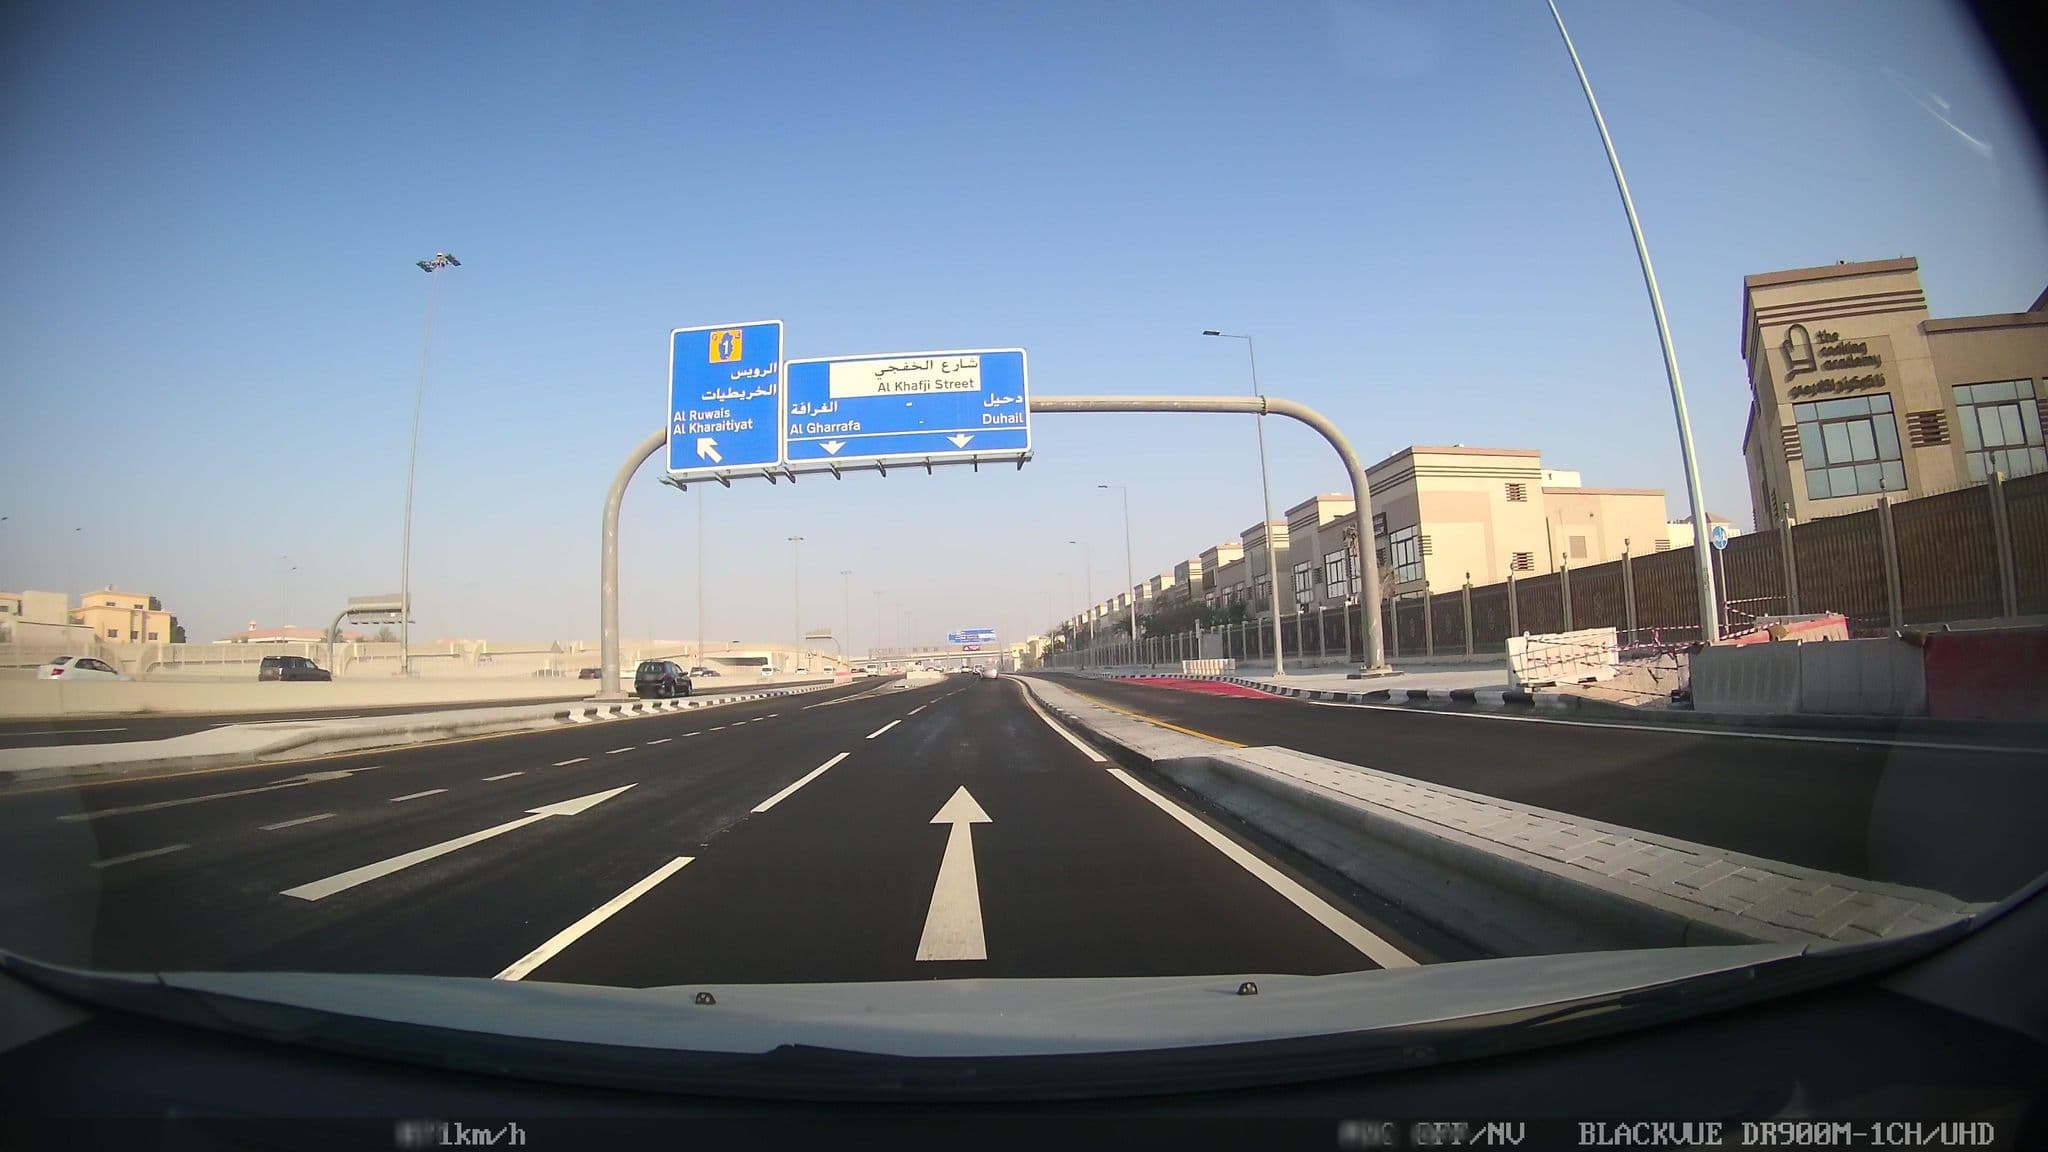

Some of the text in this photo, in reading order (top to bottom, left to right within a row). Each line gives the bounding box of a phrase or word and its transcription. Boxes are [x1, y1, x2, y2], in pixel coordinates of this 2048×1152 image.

[1816, 329, 1839, 343] the
[722, 340, 729, 355] 1
[730, 361, 777, 380] الرويس
[874, 358, 978, 380] شارع الخفجي
[1820, 354, 1882, 371] academy
[701, 383, 777, 402] الخريطيات
[877, 378, 975, 393] Al Khafji Street
[983, 392, 1024, 408] دحيل
[673, 407, 731, 423] Al Ruwais
[790, 400, 838, 417] الغرافة
[673, 418, 754, 435] Al Kharaitiyat
[982, 412, 1025, 425] Duhail
[789, 419, 861, 435] Al Gharrafa
